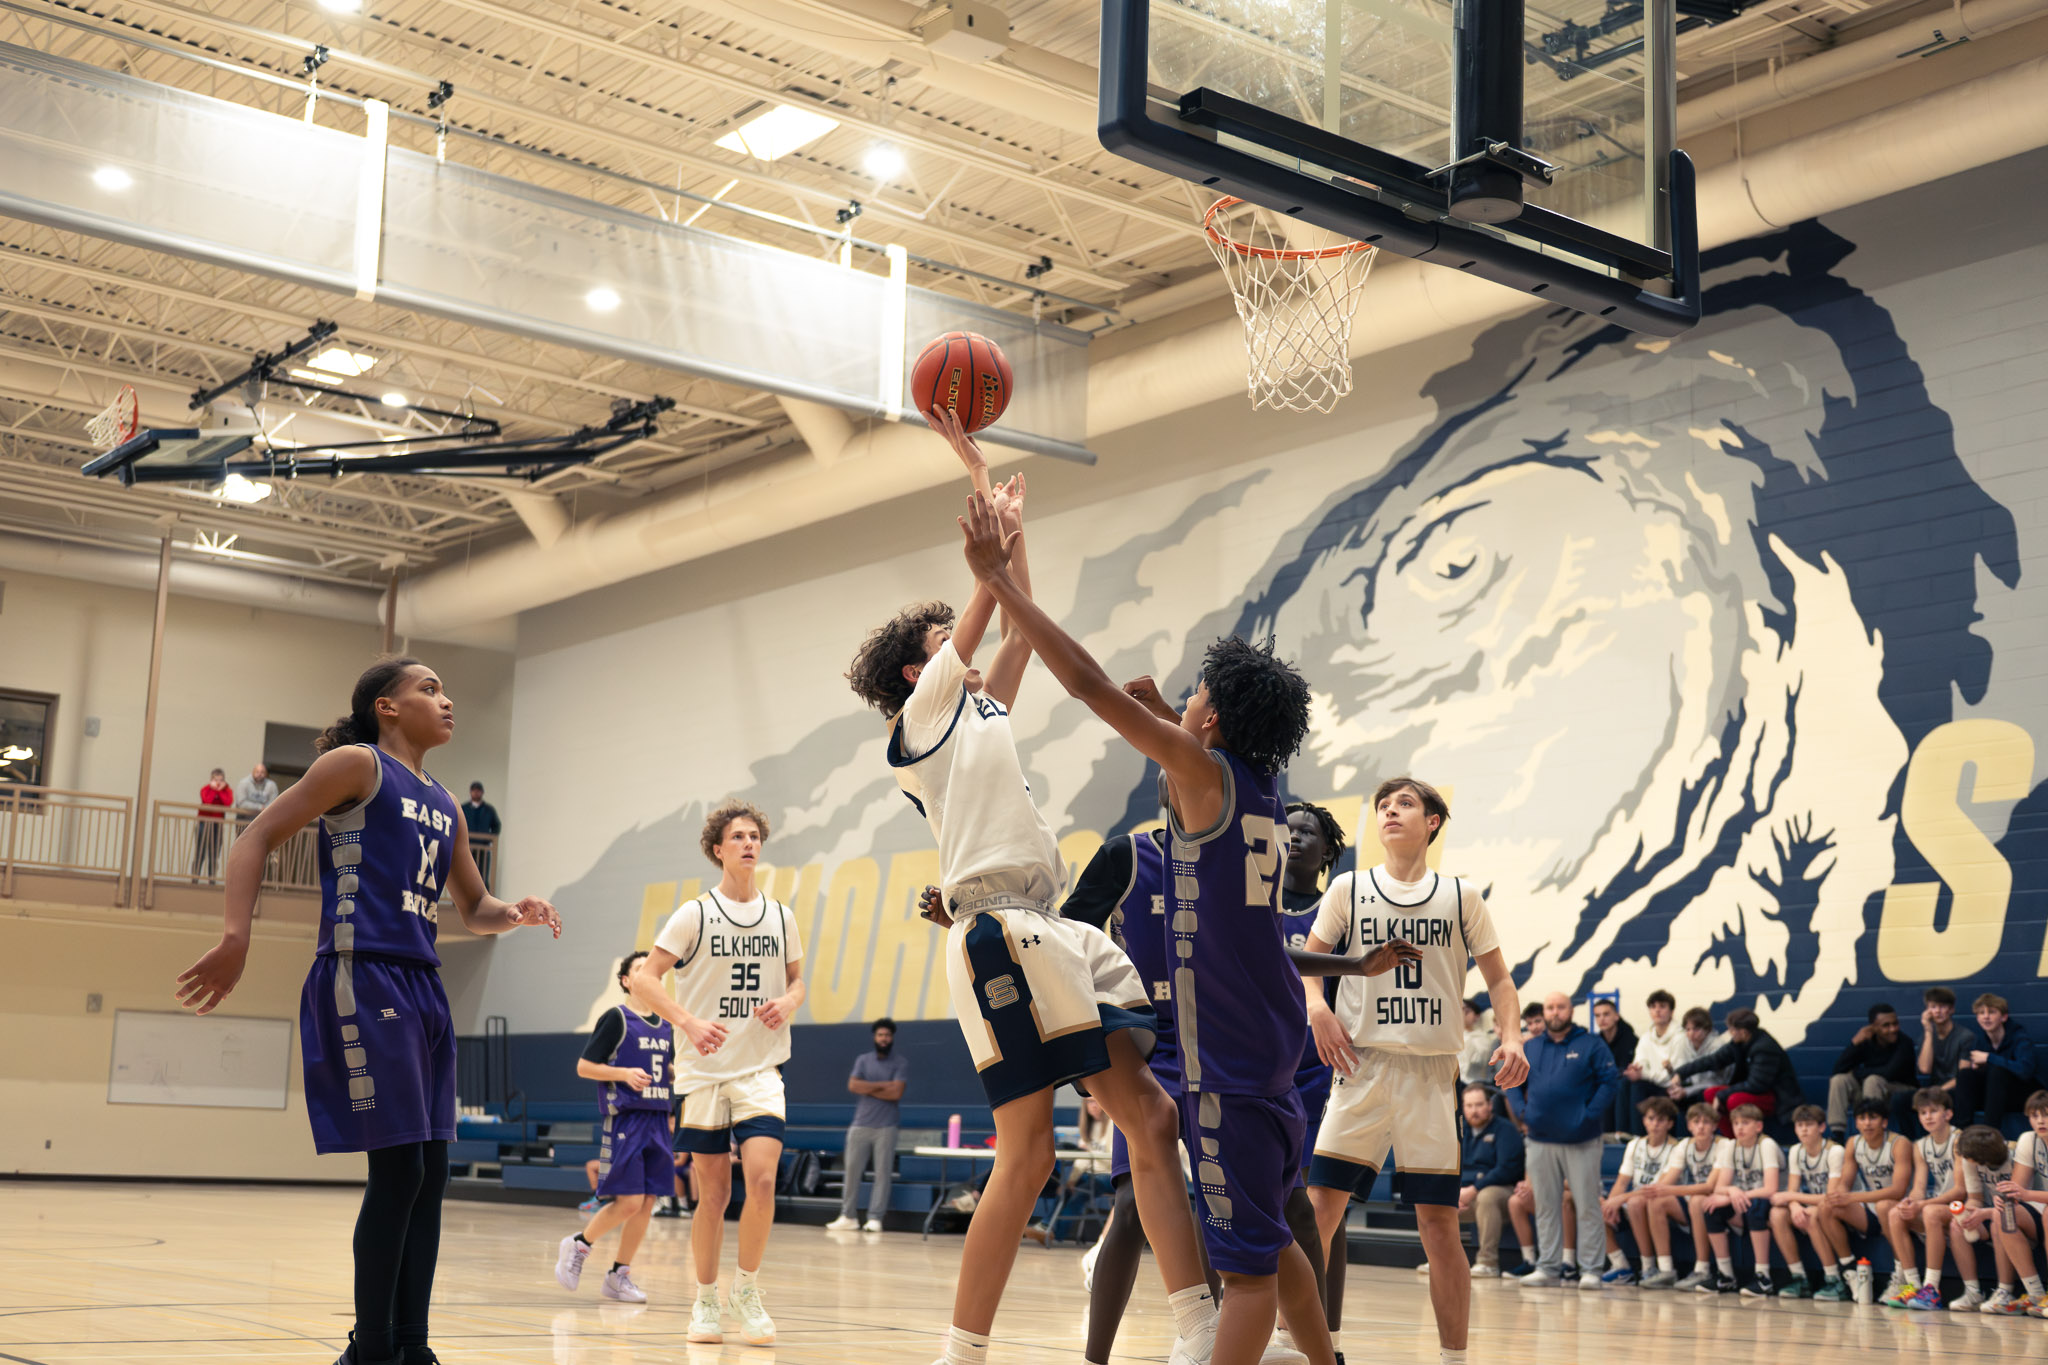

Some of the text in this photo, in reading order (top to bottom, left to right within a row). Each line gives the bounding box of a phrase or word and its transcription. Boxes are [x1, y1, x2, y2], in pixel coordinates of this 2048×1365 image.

[401, 797, 452, 838] EAST
[1877, 717, 2048, 982] S
[711, 935, 779, 957] ELKHORN
[1361, 917, 1453, 948] ELKHORN
[731, 962, 761, 991] 35
[1376, 996, 1442, 1026] SOUTH
[652, 1054, 663, 1083] 5
